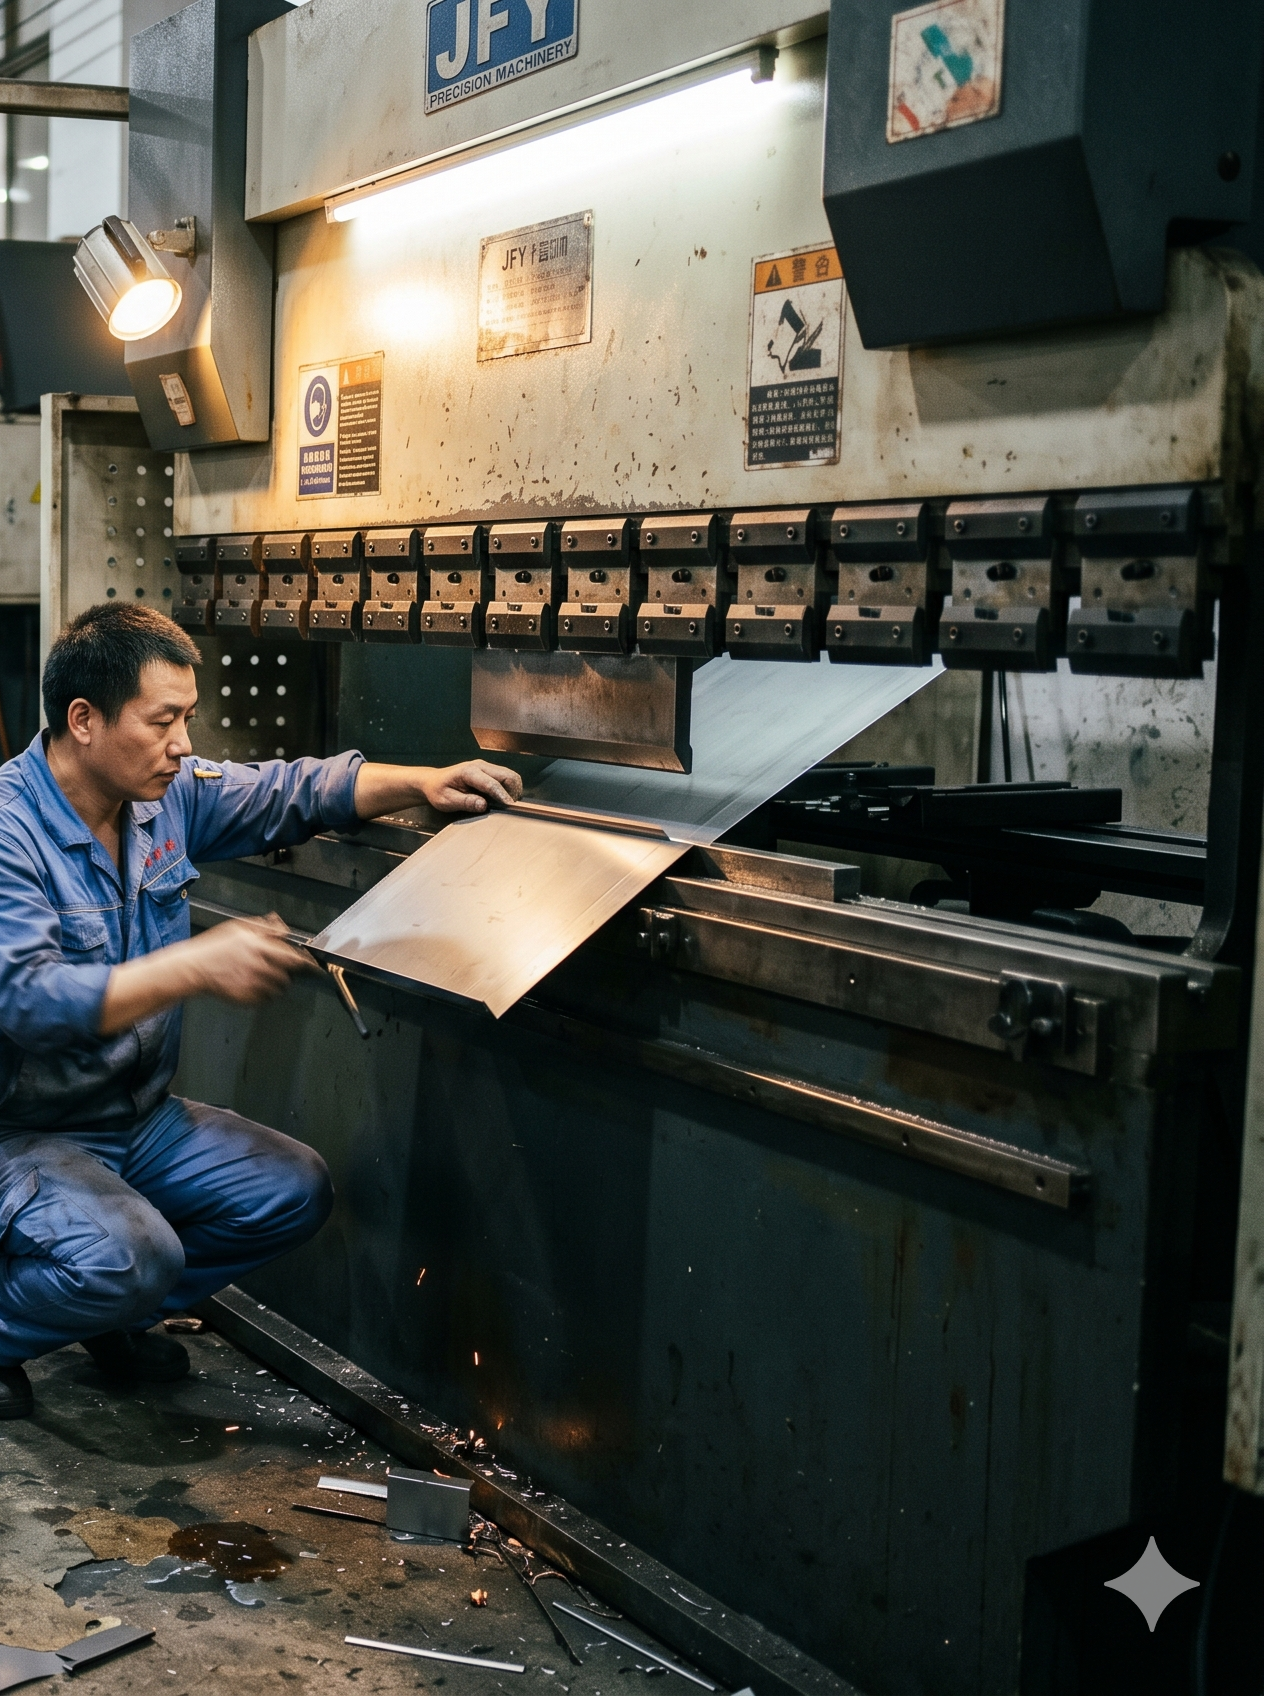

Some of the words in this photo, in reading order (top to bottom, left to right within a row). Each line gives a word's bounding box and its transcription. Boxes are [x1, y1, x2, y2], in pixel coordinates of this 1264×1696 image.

[430, 72, 492, 109] PRECISION
[496, 39, 573, 82] MACHINERY
[436, 0, 549, 80] JFY
[502, 245, 527, 271] JFY
